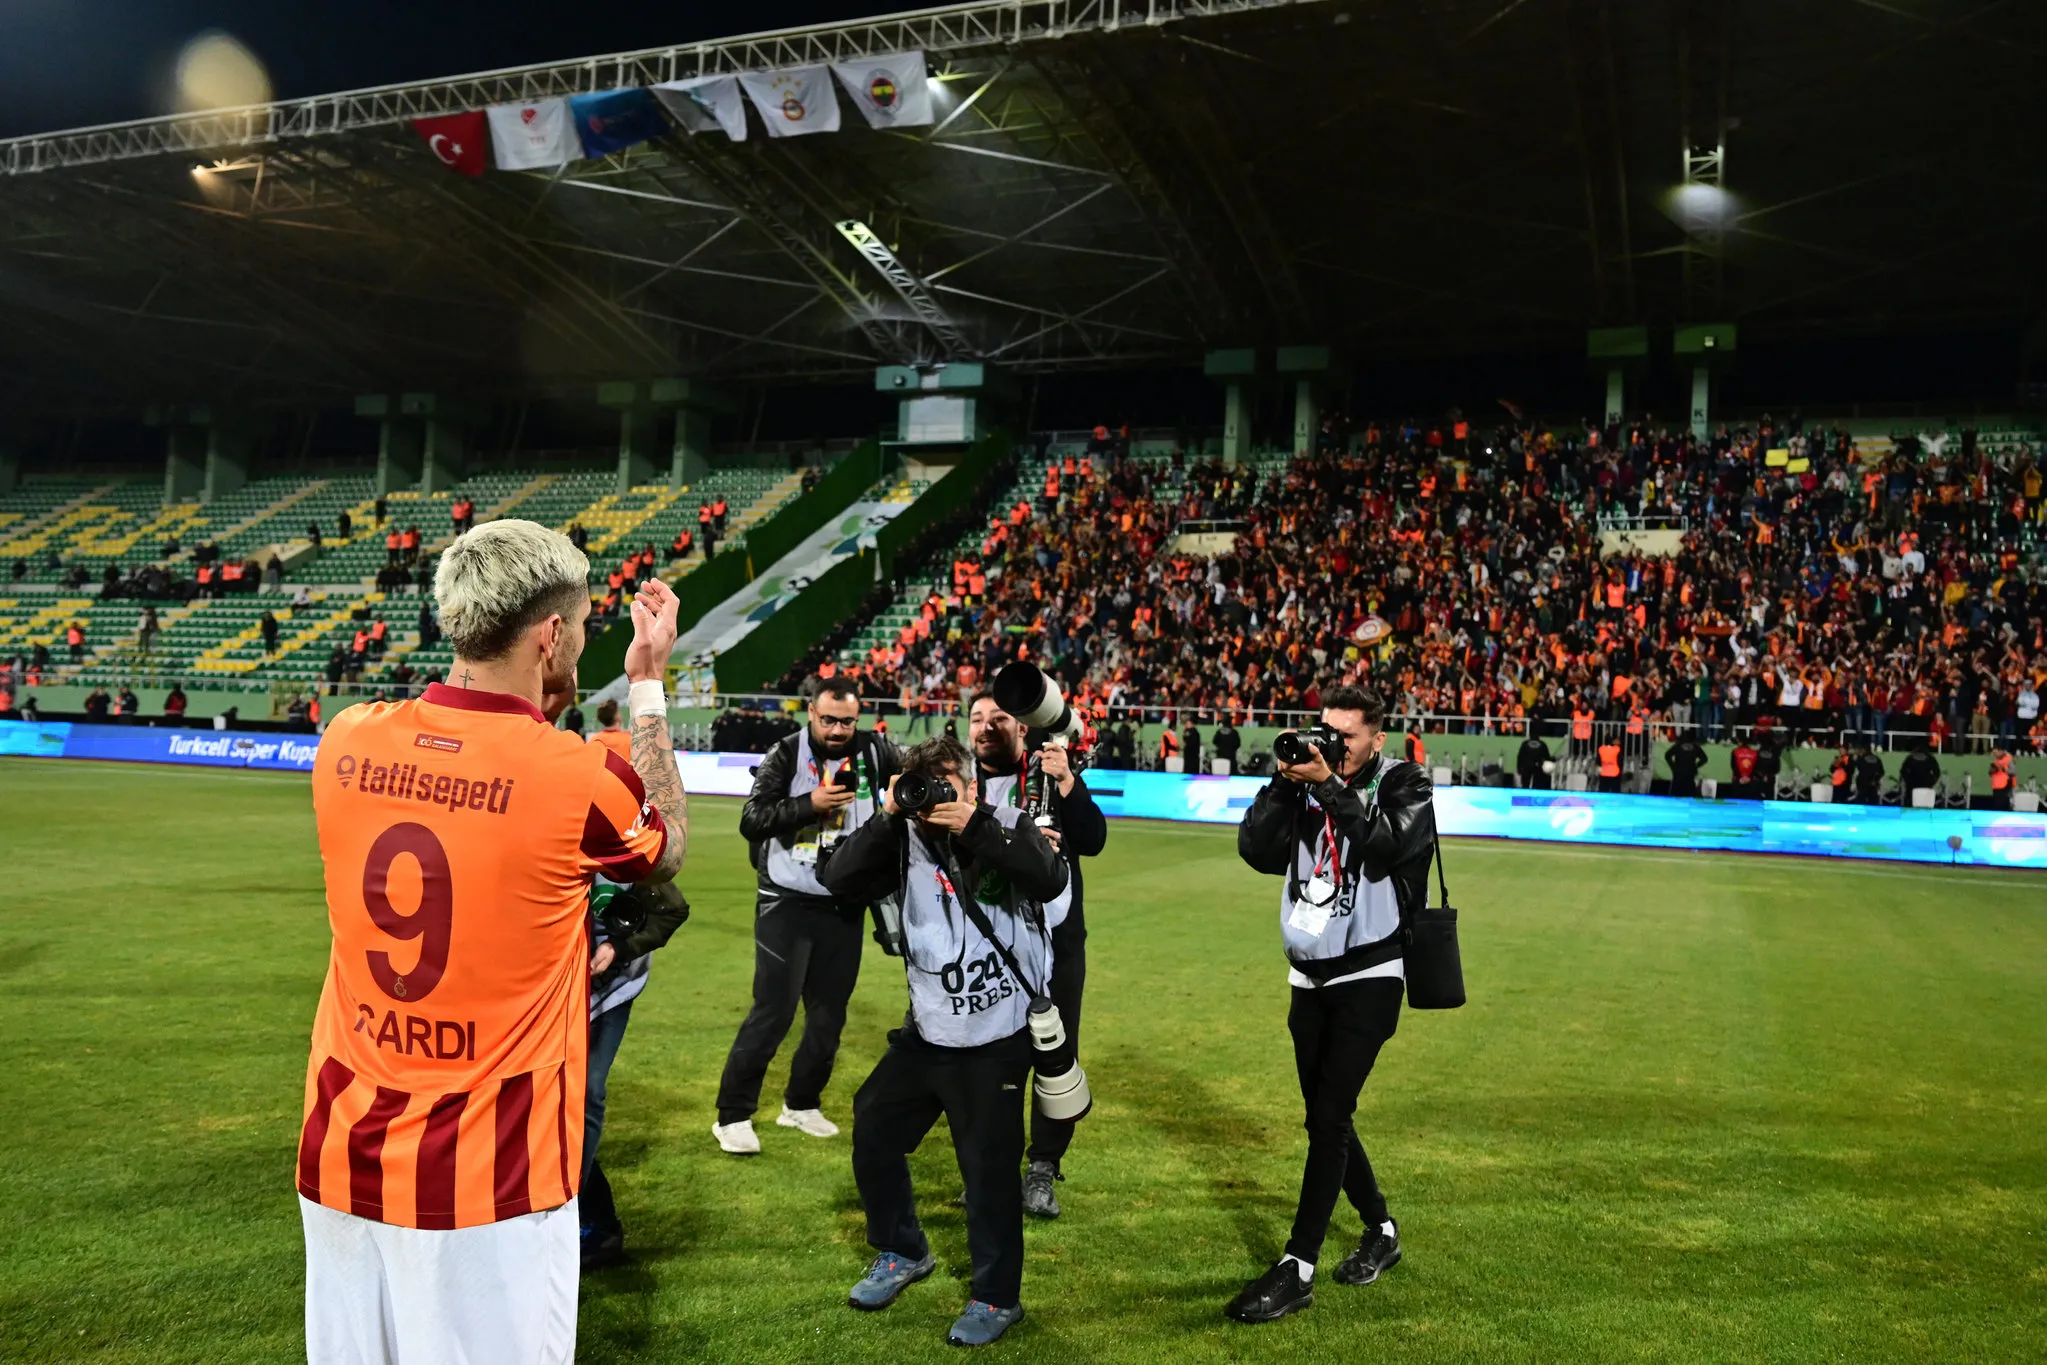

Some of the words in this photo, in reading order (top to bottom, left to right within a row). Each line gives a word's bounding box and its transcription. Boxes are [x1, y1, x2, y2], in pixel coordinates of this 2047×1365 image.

[168, 734, 231, 757] Turkcell
[359, 757, 515, 815] tatilsepeti
[361, 821, 453, 1003] 9
[949, 977, 1020, 1016] PRES
